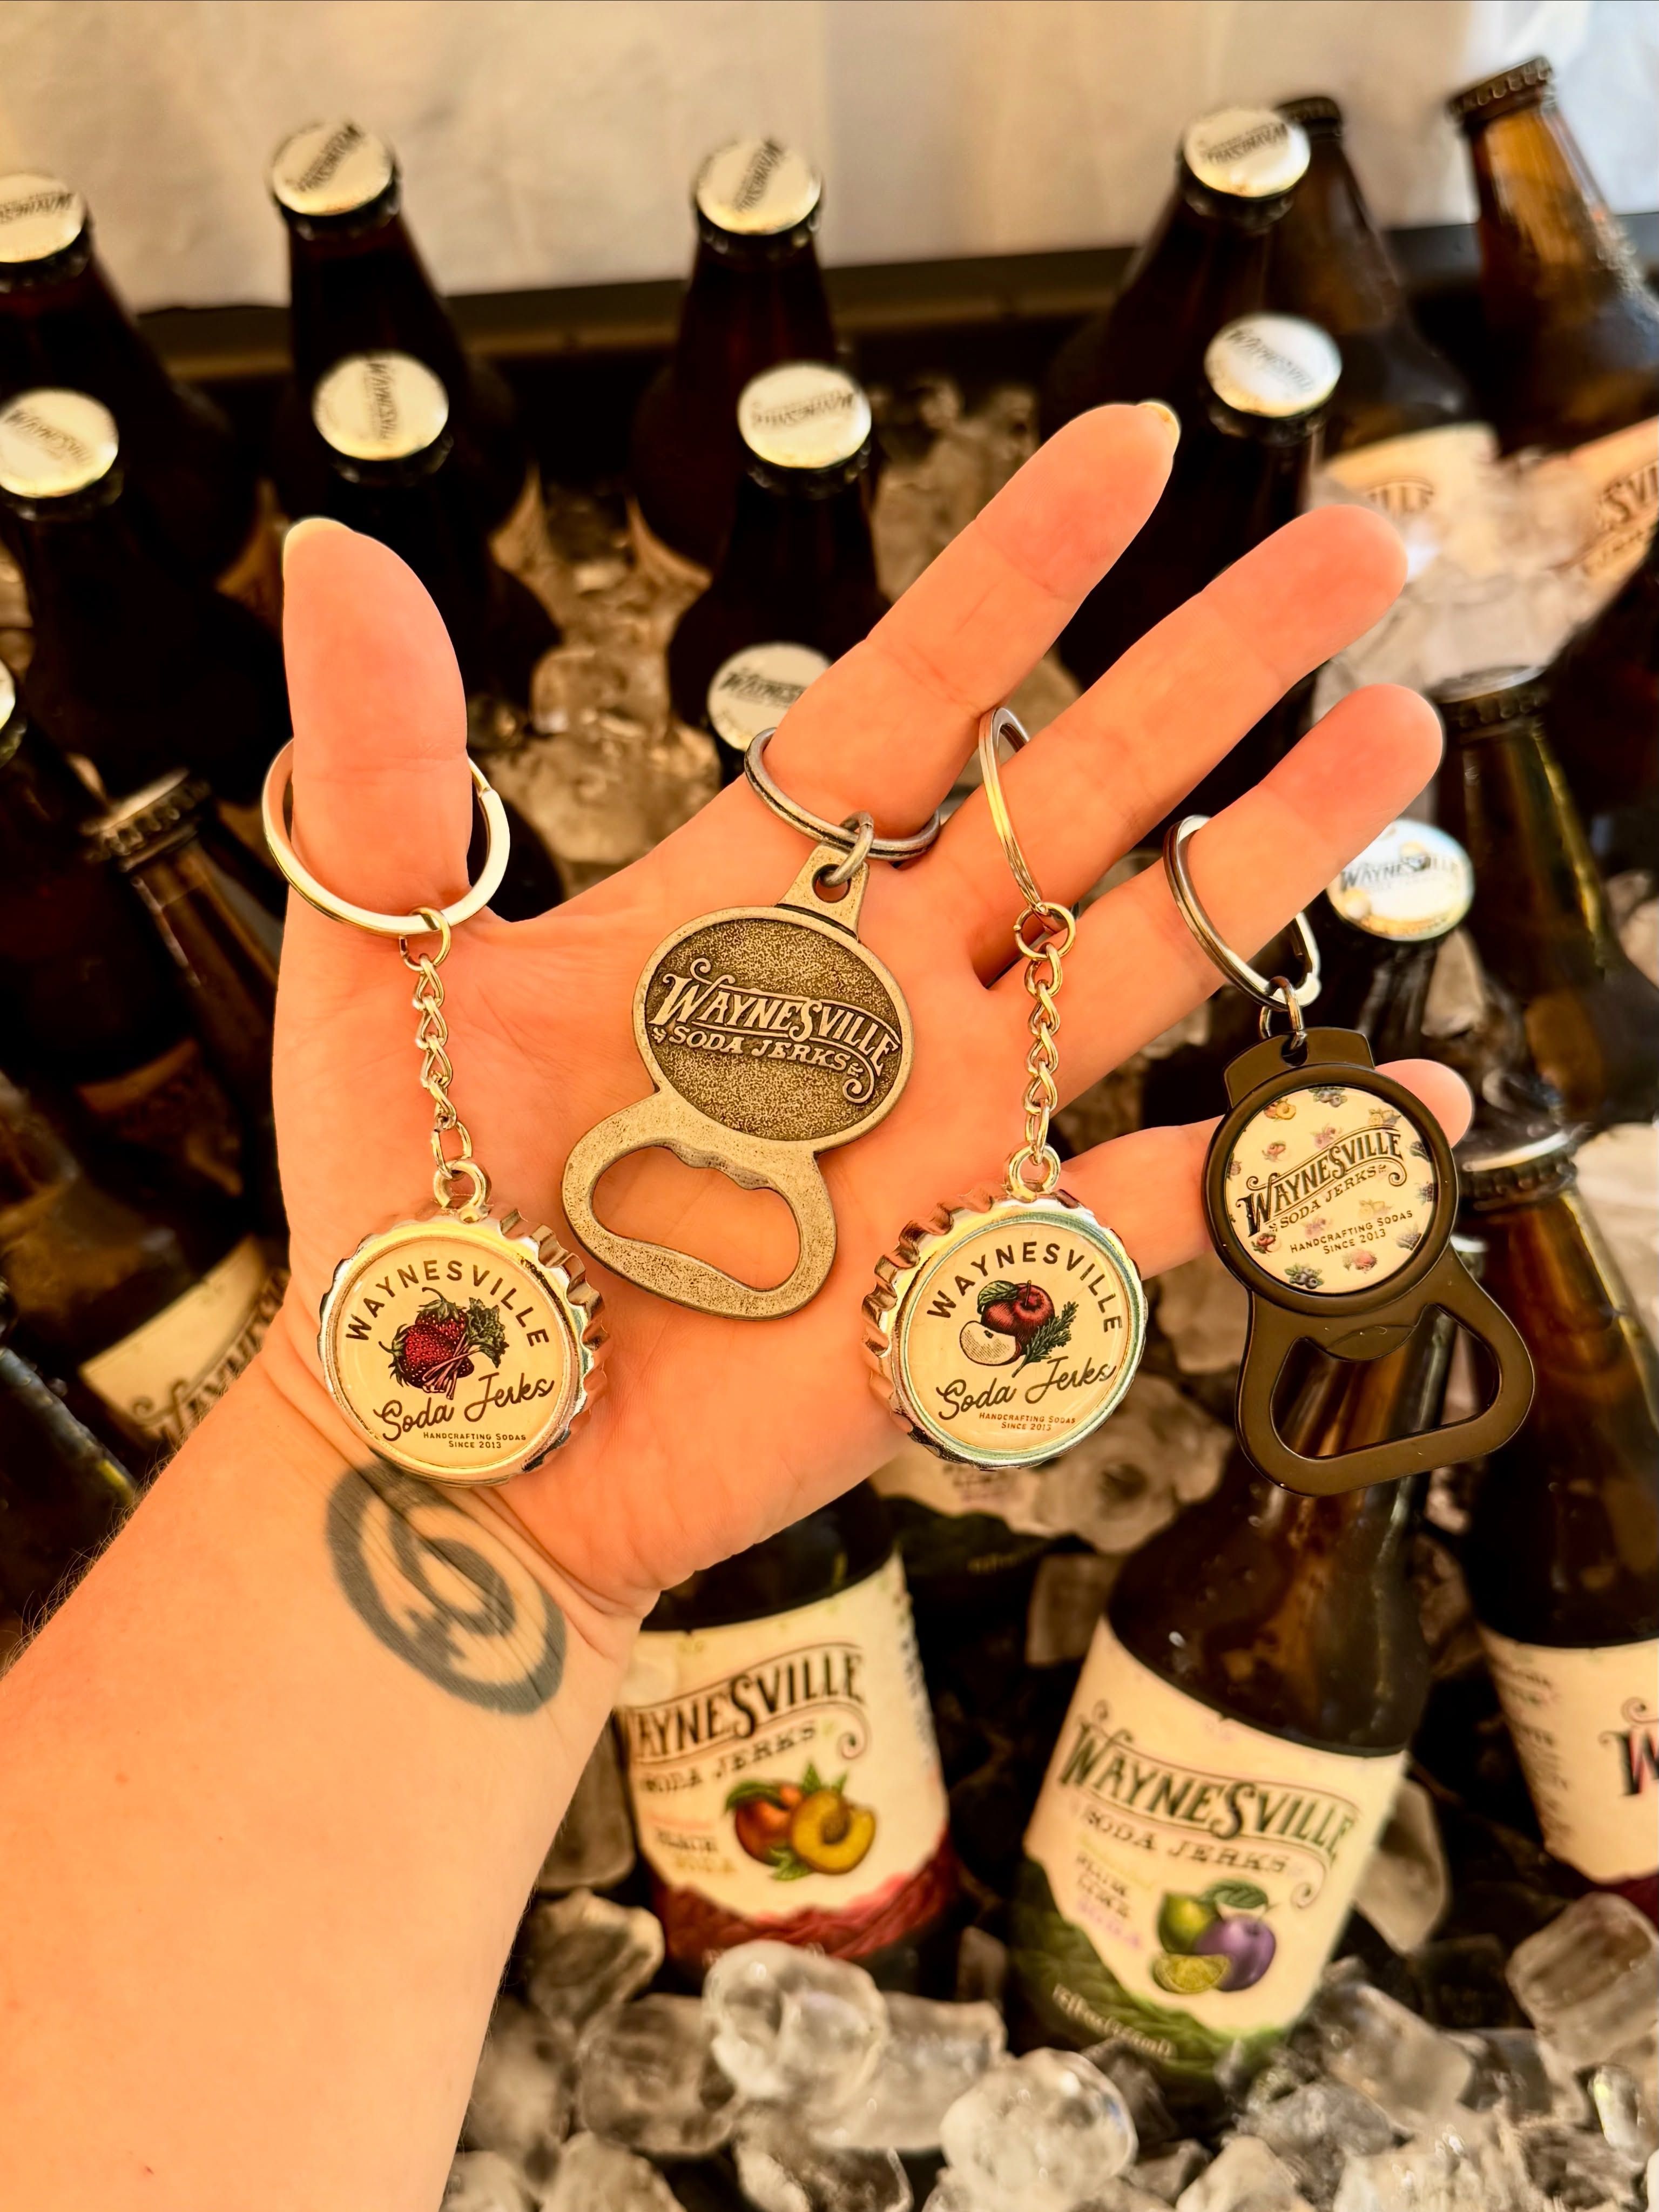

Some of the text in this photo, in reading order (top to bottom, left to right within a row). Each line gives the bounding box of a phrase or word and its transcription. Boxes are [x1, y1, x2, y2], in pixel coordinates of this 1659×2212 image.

[649, 958, 901, 1078] WAYNESVILLE
[669, 1026, 851, 1073] SODA JERKS
[1236, 1130, 1405, 1238] WAYNESVILLE
[1279, 1164, 1377, 1230] SODA JERKS
[1290, 1210, 1413, 1254] HANDCRAFTING SODAS
[1323, 1229, 1386, 1255] SINCE 2013
[346, 1259, 550, 1347] WAYNESVILLE
[927, 1241, 1123, 1333] WAYNESVILLE
[373, 1372, 555, 1442] Soda Jerks
[935, 1355, 1117, 1420] Soda Jerks
[979, 1412, 1076, 1425] HANDCRAFTING SODAS
[423, 1431, 527, 1441] HANDCRAFTING SODAS
[448, 1440, 502, 1449] SINCE 2013
[1001, 1421, 1052, 1432] SINCE 2013
[715, 1722, 816, 1778] JERKS
[1058, 1713, 1356, 1866] WAYNESVILLE
[1085, 1807, 1291, 1874] SODA JERKS
